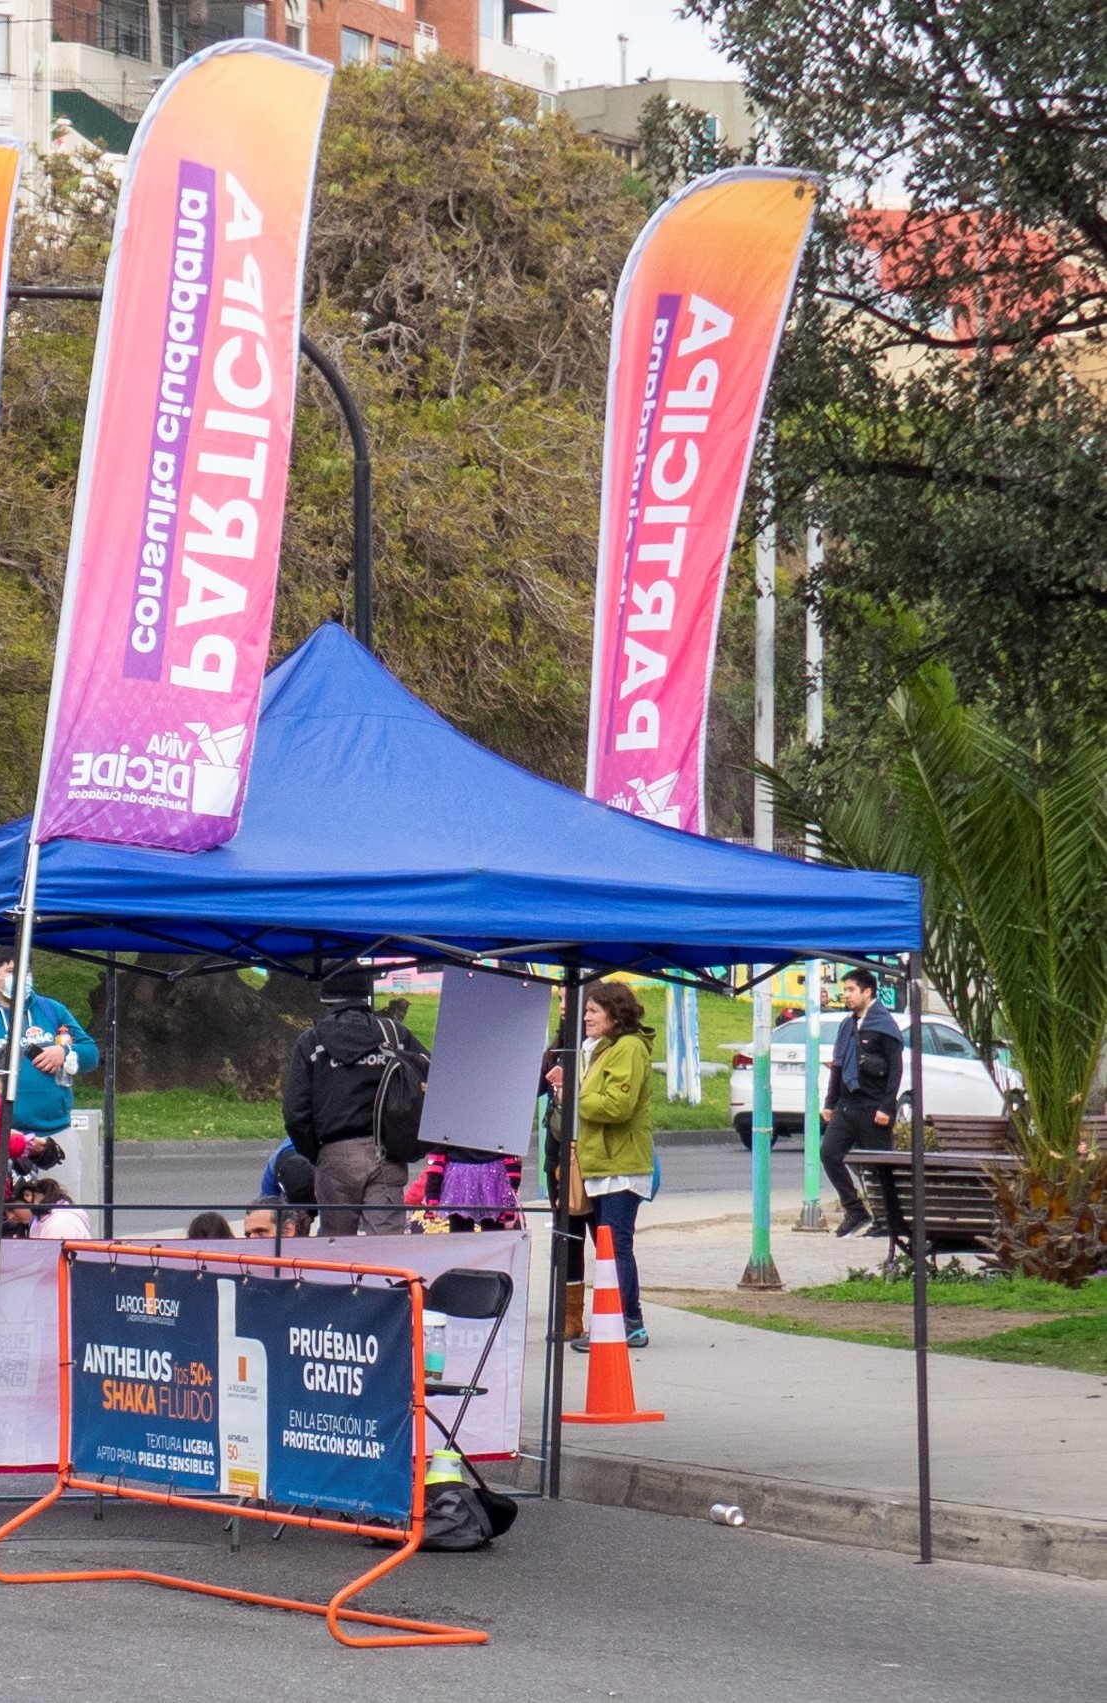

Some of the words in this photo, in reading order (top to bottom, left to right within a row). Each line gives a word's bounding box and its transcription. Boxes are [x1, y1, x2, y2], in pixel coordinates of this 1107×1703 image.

[289, 1323, 379, 1364] PRUÉBALO
[82, 1342, 173, 1382] ANTHELIOS
[189, 1362, 213, 1386] 50+
[303, 1361, 364, 1396] GRATIS
[102, 1379, 157, 1415] SHAKA
[159, 1385, 213, 1423] FLUIDO
[289, 1409, 303, 1428] EN
[303, 1411, 316, 1430] LA
[316, 1412, 361, 1437] ESTACIÓN
[364, 1419, 378, 1438] DE
[145, 1432, 182, 1451] TEXTURA
[183, 1438, 215, 1456] LIGERA
[282, 1430, 344, 1455] PROTECCIÓN
[96, 1445, 117, 1462] APTO
[117, 1448, 138, 1465] PARA
[138, 1450, 167, 1469] PIELES
[167, 1455, 215, 1476] SENSIBLES
